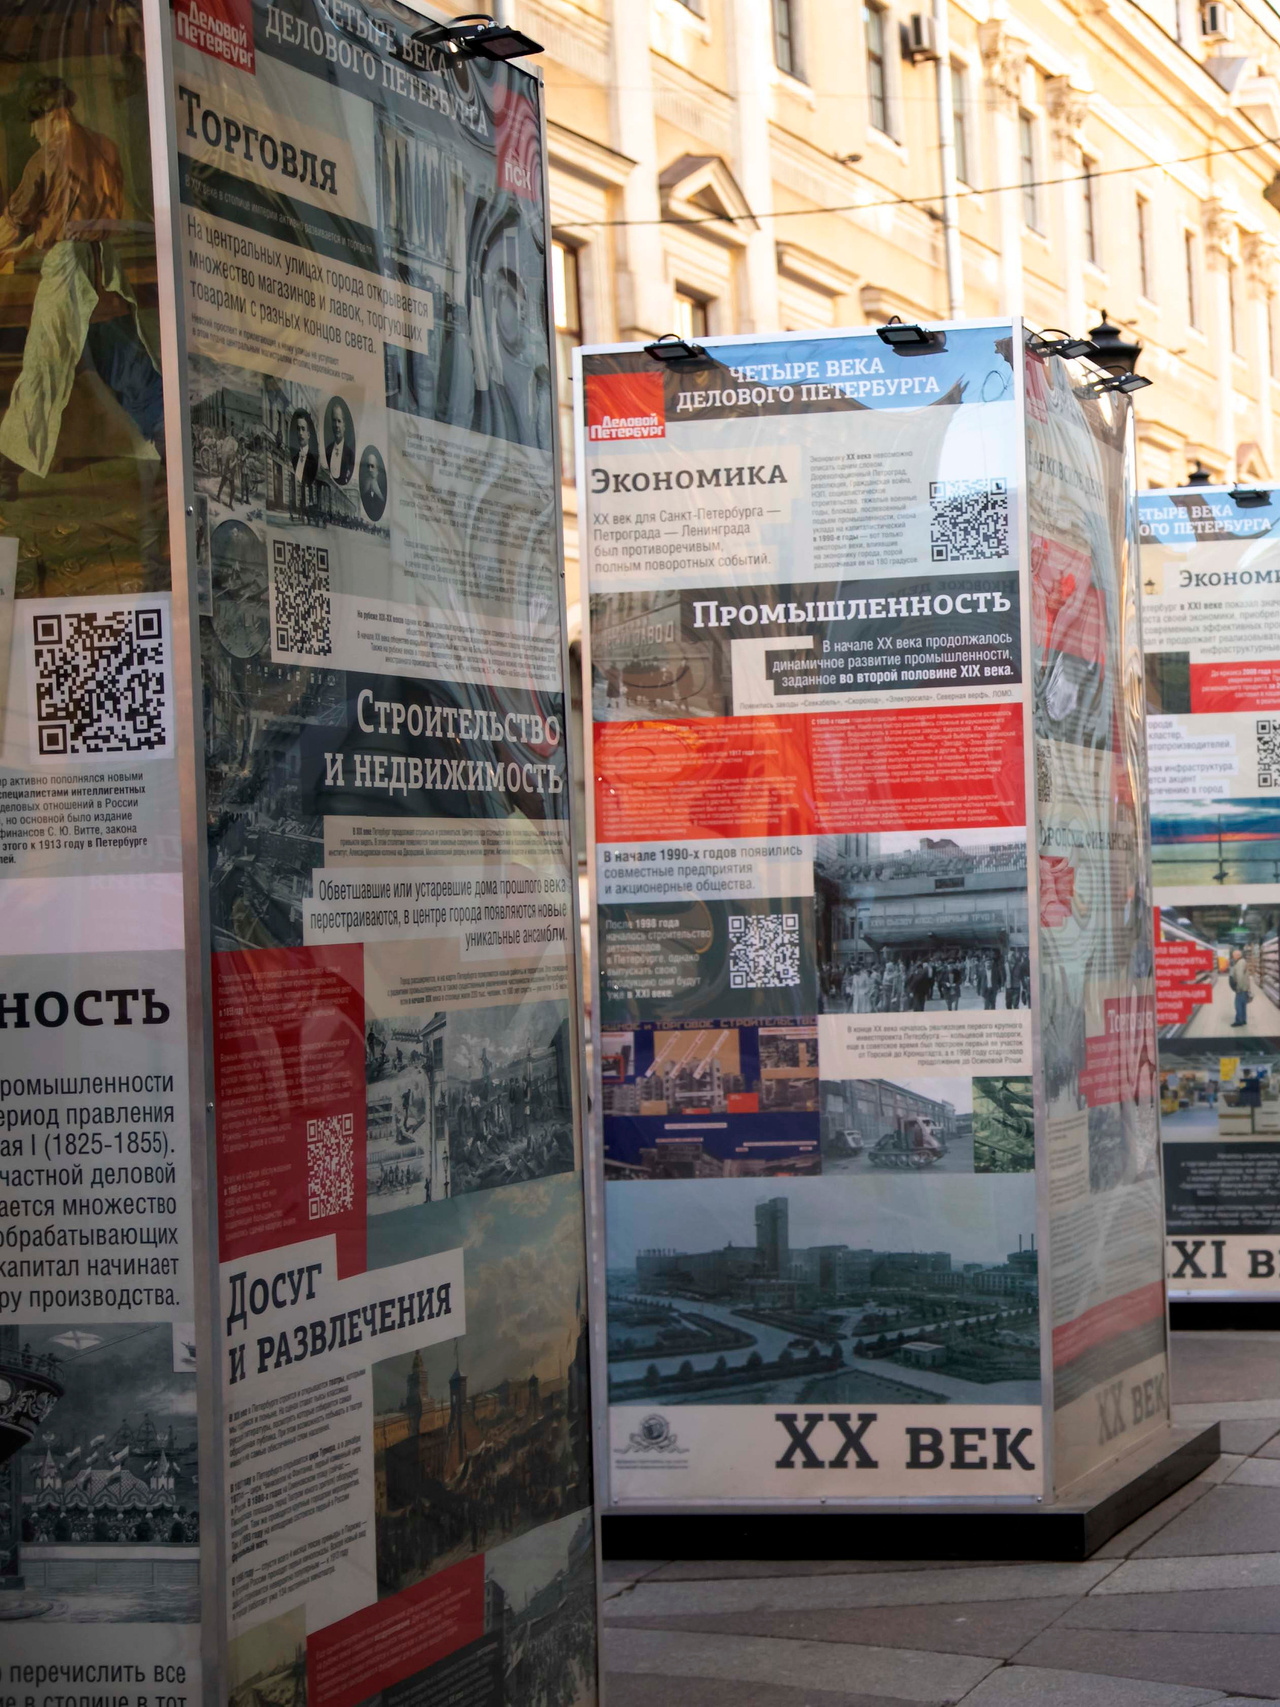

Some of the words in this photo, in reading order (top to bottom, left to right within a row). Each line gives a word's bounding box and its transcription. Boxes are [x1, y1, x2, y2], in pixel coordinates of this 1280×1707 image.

[402, 33, 449, 81] ВЕКА
[265, 5, 377, 81] ДЕЛОВОГО
[381, 59, 490, 138] ПЕТЕРБУРГА
[504, 161, 533, 191] ПСК
[186, 214, 202, 239] На
[205, 227, 282, 266] центральных
[284, 255, 324, 282] улицах
[326, 270, 364, 296] города
[366, 283, 428, 315] открывается
[188, 250, 255, 286] множество
[258, 275, 316, 307] магазинов
[319, 295, 326, 310] и
[329, 298, 365, 322] лавок,
[366, 310, 422, 342] торгующих
[189, 280, 247, 312] товарами
[250, 300, 257, 316] с
[259, 303, 301, 330] разных
[303, 317, 342, 343] концов
[344, 331, 376, 352] света.
[728, 362, 820, 382] ЧЕТЫРЕ
[825, 357, 885, 376] ВЕКА
[676, 385, 794, 411] ДЕЛОВОГО
[800, 377, 940, 400] ПЕТЕРБУРГА
[612, 515, 632, 524] век
[634, 513, 656, 524] для
[659, 507, 764, 521] Санкт-Петербурга
[1192, 504, 1234, 518] ВЕКА
[593, 528, 661, 541] Петрограда
[681, 524, 751, 536] Ленинграда
[1174, 518, 1273, 534] ПЕТЕРБУРГА
[594, 545, 618, 556] был
[621, 542, 723, 556] противоречивым,
[594, 562, 641, 572] полным
[644, 558, 715, 570] поворотных
[718, 553, 772, 566] событий.
[822, 639, 831, 652] В
[834, 640, 874, 651] начале
[896, 637, 923, 648] века
[925, 633, 1013, 648] продолжалось
[772, 658, 845, 672] динамичное
[847, 655, 901, 669] развитие
[904, 650, 1013, 665] промышленности,
[781, 674, 836, 687] заданное
[839, 673, 854, 683] во
[856, 670, 898, 684] второй
[900, 668, 957, 680] половине
[983, 665, 1014, 676] века.
[9, 777, 48, 785] активно
[50, 774, 105, 783] пополнялся
[107, 773, 143, 781] новыми
[324, 752, 345, 786] И
[353, 753, 563, 797] НЕДВИЖИМОСТЬ
[42, 800, 94, 810] отношений
[96, 800, 103, 808] в
[104, 799, 139, 807] России
[5, 816, 18, 824] но
[19, 814, 65, 824] основной
[66, 813, 92, 822] было
[93, 812, 133, 822] издание
[47, 826, 58, 836] С.
[59, 826, 72, 835] Ю.
[73, 826, 103, 835] Витте,
[105, 825, 137, 833] закона
[2, 842, 28, 850] этого
[38, 840, 62, 849] 1913
[63, 840, 85, 849] году
[95, 837, 148, 848] Петербурге
[603, 851, 612, 862] В
[614, 851, 656, 861] начале
[659, 848, 700, 860] 1990-х
[703, 848, 737, 859] годов
[740, 846, 803, 856] появились
[604, 867, 674, 878] совместные
[677, 864, 753, 877] предприятия
[319, 880, 391, 900] Обветшавшие
[393, 883, 412, 897] или
[414, 881, 472, 900] устаревшие
[474, 880, 498, 897] дома
[500, 879, 542, 897] прошлого
[544, 878, 566, 892] века
[604, 885, 612, 893] и
[615, 882, 693, 894] акционерные
[695, 879, 756, 891] общества.
[310, 910, 401, 930] перестраиваются,
[403, 909, 410, 924] в
[412, 908, 447, 926] центре
[449, 906, 482, 923] города
[484, 904, 536, 919] появляются
[538, 903, 566, 917] новые
[465, 930, 521, 951] уникальные
[522, 924, 568, 942] ансамбли.
[0, 1164, 83, 1186] частной
[90, 1163, 176, 1187] деловой
[0, 1259, 79, 1277] капитал
[87, 1258, 179, 1275] начинает
[1167, 1240, 1227, 1279] XI
[229, 1343, 246, 1386] И
[256, 1281, 452, 1374] РАЗВЛЕЧЕНИЯ
[905, 1426, 1036, 1470] ВЕК
[10, 1665, 146, 1687] перечислить
[154, 1665, 186, 1683] все
